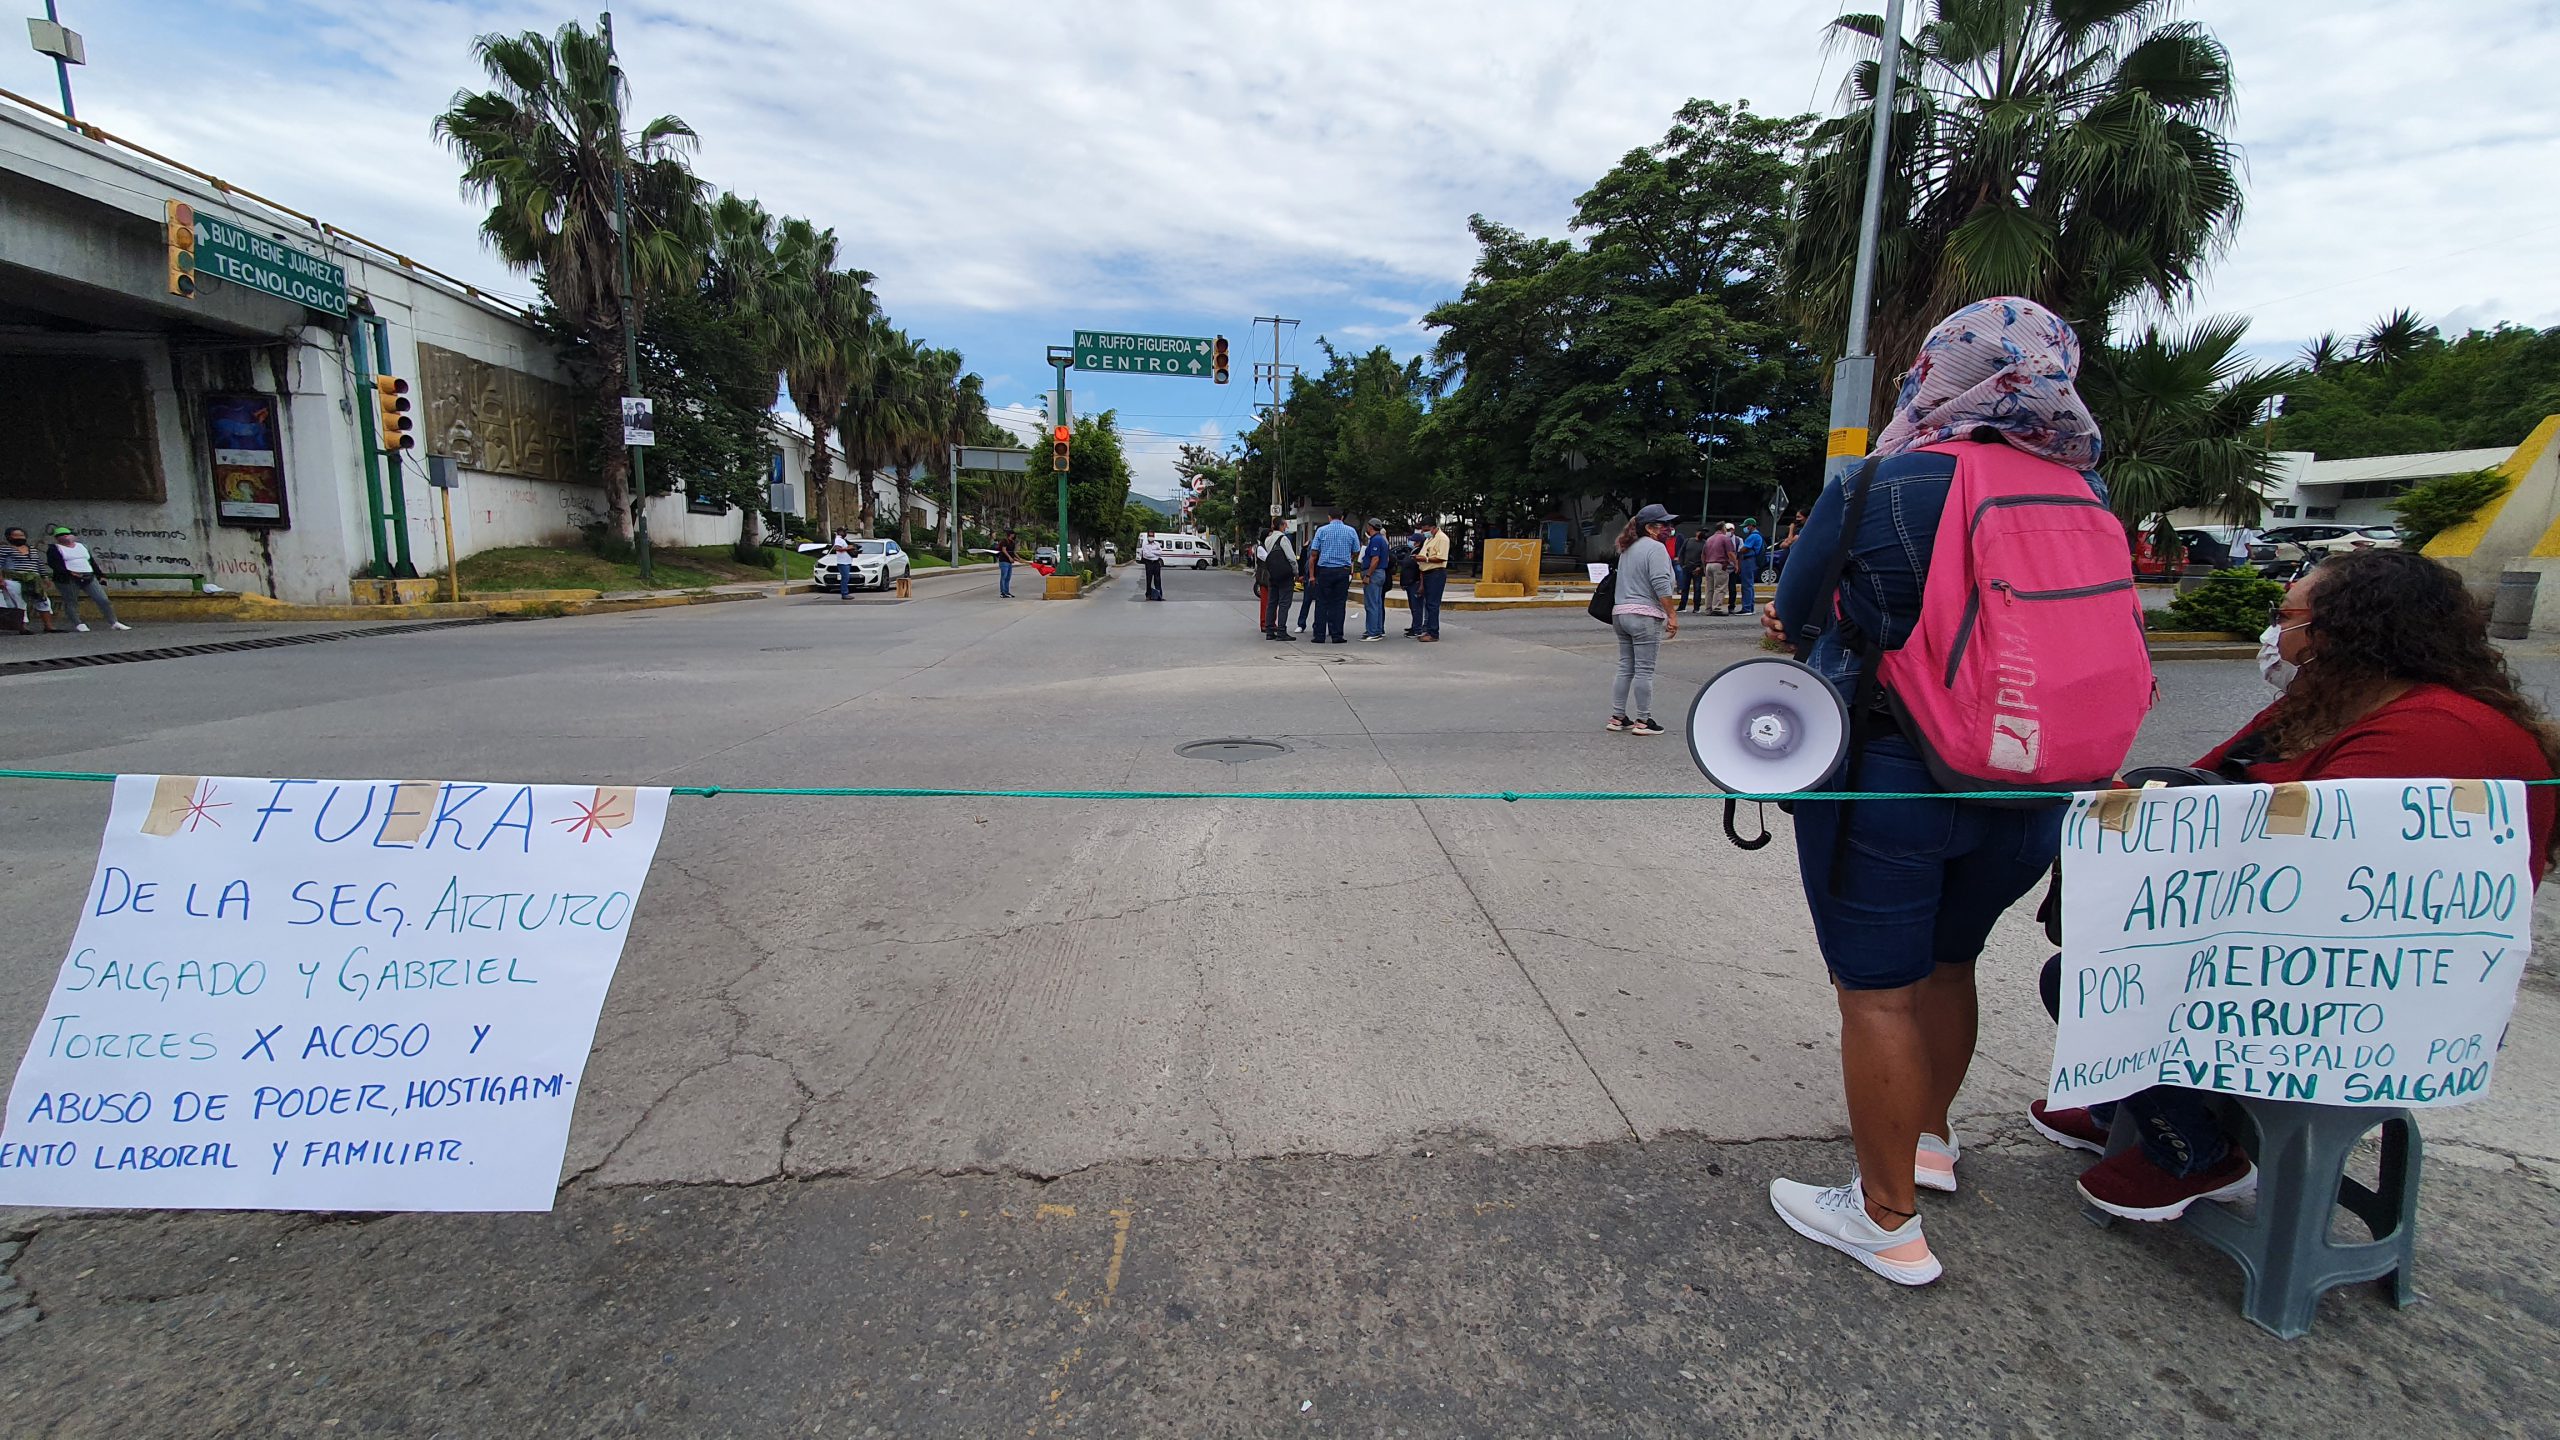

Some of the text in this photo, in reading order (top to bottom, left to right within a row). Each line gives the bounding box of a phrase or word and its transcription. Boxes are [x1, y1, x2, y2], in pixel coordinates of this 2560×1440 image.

[211, 223, 345, 288] BLVD. RENE JUAREZ C.
[214, 252, 345, 313] TECNOLOGICO
[1078, 334, 1191, 353] AV. RUFFO FIGUEROA
[1085, 354, 1180, 372] CENTRO
[1496, 541, 1537, 566] 237
[252, 779, 533, 853] FUERA
[2310, 788, 2357, 841] LA
[96, 866, 632, 938] DE LA SEG. ARTURO
[2123, 862, 2518, 932] ARTURO SALGADO
[66, 946, 539, 1002] SALGADO Y GABRIEL
[2078, 944, 2505, 1020] POR PREPOTENTE Y
[49, 1014, 492, 1062] TORRES X ACOSO Y
[2168, 999, 2384, 1038] CORRUPTO
[2053, 1033, 2482, 1094] ARGUMENTA RESPALDO POR
[2157, 1059, 2490, 1102] EVELYN SALGADO
[28, 1091, 152, 1124] ABUSO
[173, 1091, 229, 1122] DE
[254, 1084, 398, 1117] PODER,
[0, 1139, 474, 1175] ENTO LABORAL Y FAMILIAR.
